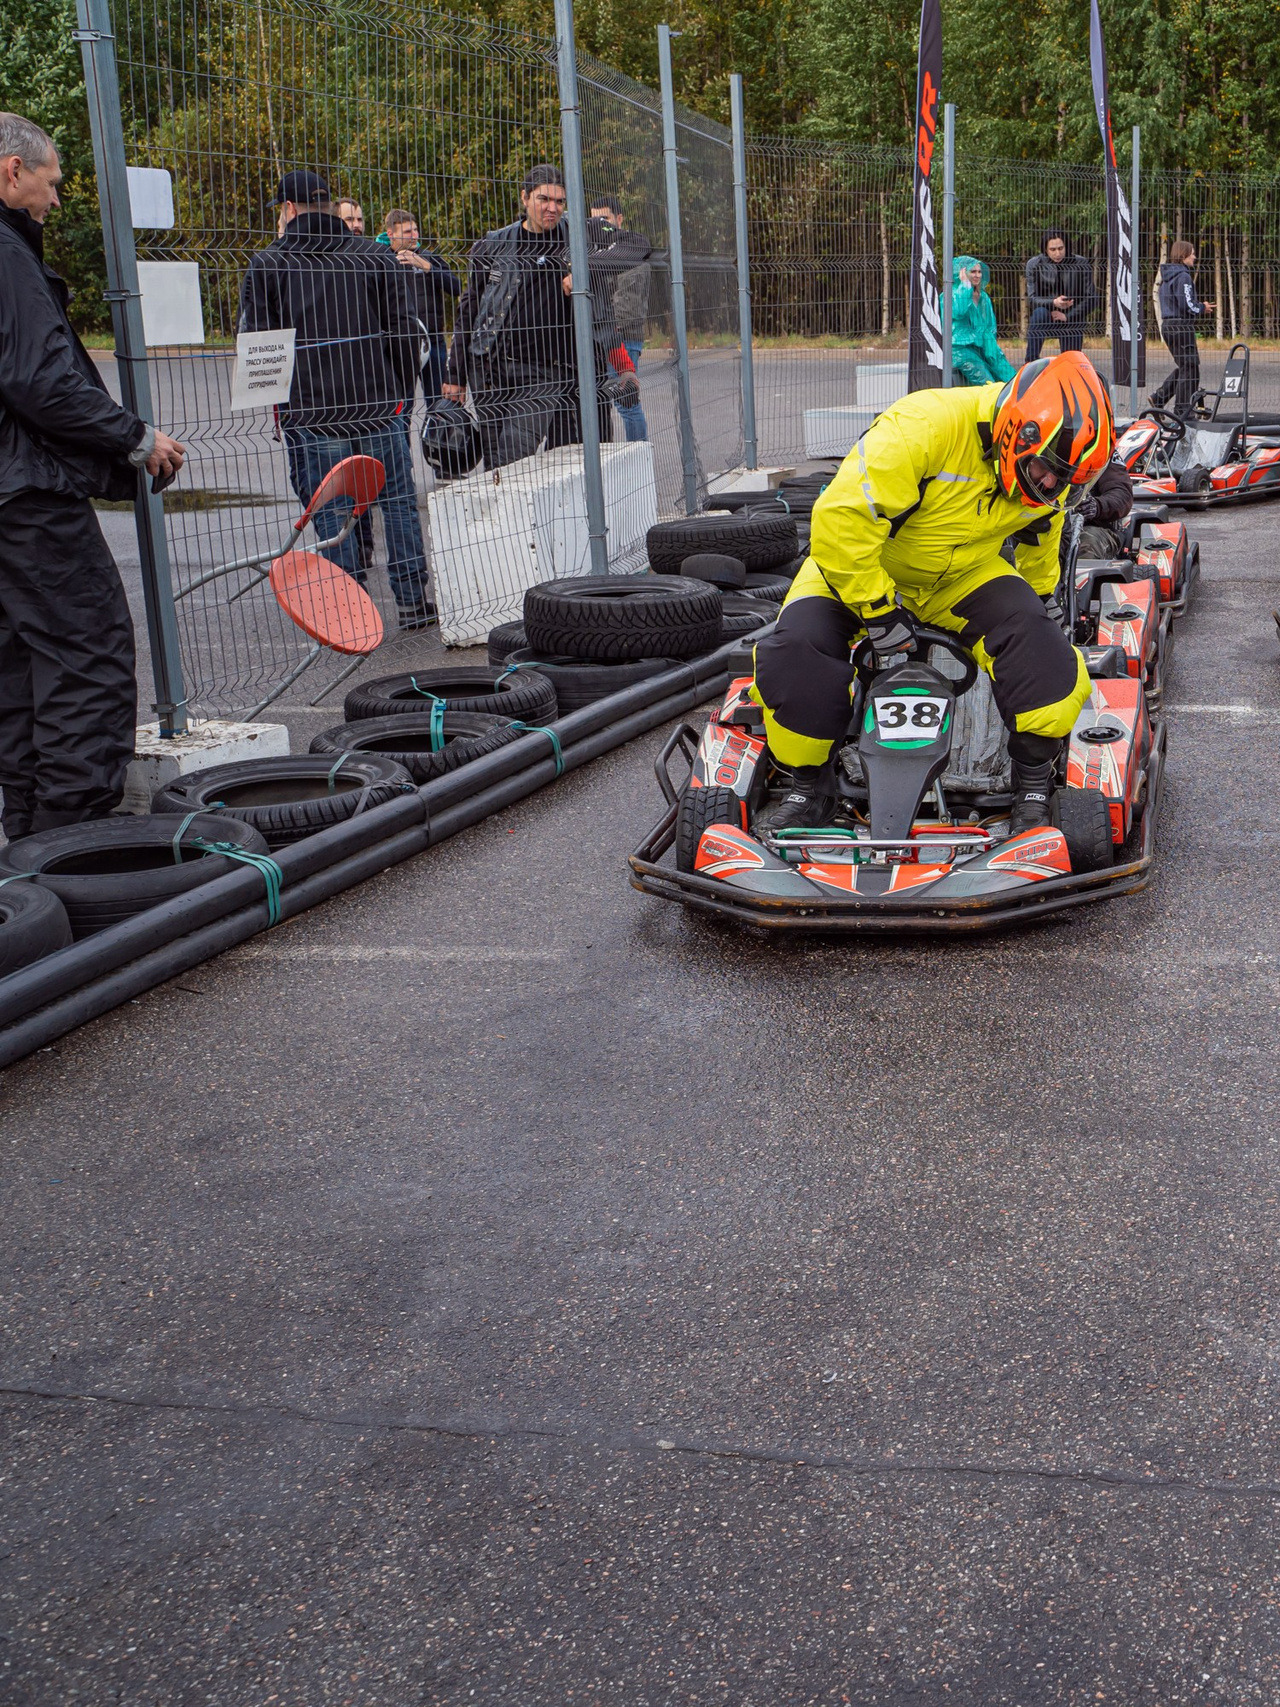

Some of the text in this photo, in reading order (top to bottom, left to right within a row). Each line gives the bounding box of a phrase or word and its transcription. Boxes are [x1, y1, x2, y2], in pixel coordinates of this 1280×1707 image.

[248, 346, 258, 355] ДЛЯ
[259, 344, 277, 353] ВЫХОДА
[246, 354, 287, 366] ТРАССУ ОЖИДАЙТЕ
[248, 367, 282, 377] ПРИГЛАШЕНИЯ
[1227, 378, 1236, 391] 4
[1127, 430, 1146, 442] 4
[878, 702, 940, 728] 38
[715, 735, 749, 786] DINO
[702, 840, 741, 857] DINO
[1015, 841, 1059, 861] DINO
